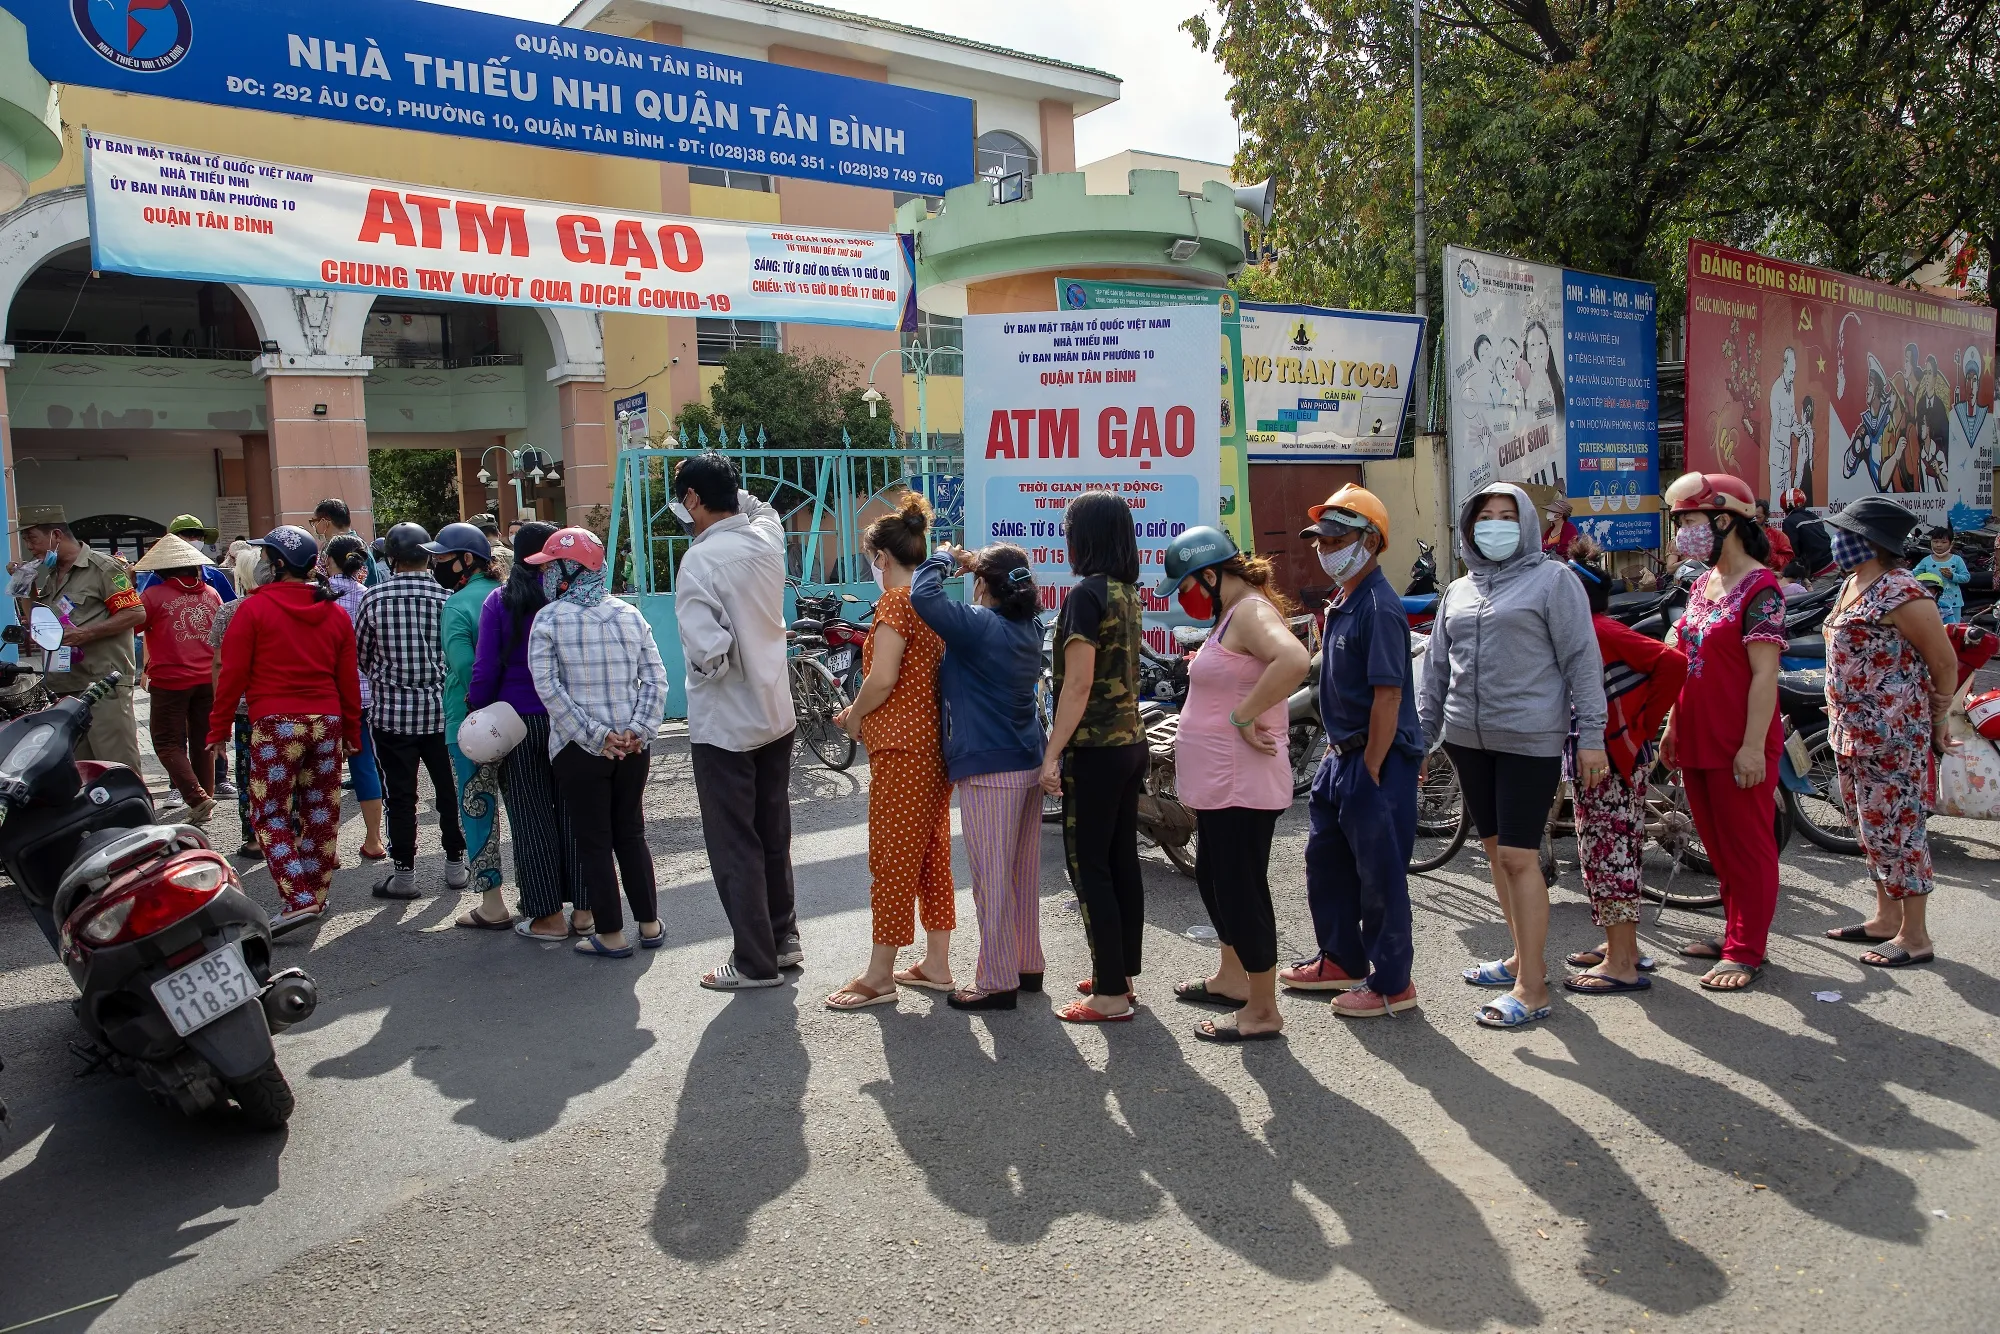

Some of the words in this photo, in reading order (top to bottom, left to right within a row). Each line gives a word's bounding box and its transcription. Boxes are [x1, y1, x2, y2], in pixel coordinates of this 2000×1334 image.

[515, 33, 577, 61] QUẬN
[584, 46, 643, 69] ĐOÀN
[649, 55, 689, 77] TÂN
[697, 62, 742, 85] BÌNH
[287, 33, 392, 81] NHÀ
[404, 52, 537, 102] THIẾU
[552, 76, 622, 114] NHI
[635, 90, 739, 134] QUẬN
[750, 103, 818, 142] TÂN
[829, 115, 905, 155] BÌNH
[227, 75, 265, 96] ĐC:
[273, 82, 312, 103] 292
[318, 85, 348, 108] ÂU
[354, 95, 392, 117] CƠ,
[398, 100, 486, 127] PHƯỜNG
[492, 114, 519, 133] 10,
[524, 118, 576, 140] QUẬN
[582, 124, 617, 144] TÂN
[623, 129, 664, 149] BÌNH
[678, 138, 705, 154] ĐT:
[709, 142, 765, 164] (028)38
[770, 153, 797, 167] 604
[800, 155, 824, 170] 351
[839, 160, 889, 180] (028)39
[893, 169, 917, 183] 749
[920, 172, 943, 186] 760
[106, 140, 133, 155] BAN
[137, 146, 165, 161] MẶT
[168, 151, 201, 166] TRẬN
[204, 155, 221, 169] TỔ
[223, 160, 255, 175] QUỐC
[258, 166, 284, 181] VIỆT
[286, 170, 314, 183] NAM
[159, 166, 187, 181] NHÀ
[190, 170, 225, 185] THIẾU
[229, 174, 250, 188] NHI
[110, 174, 127, 190] ỦY
[131, 180, 158, 195] BAN
[161, 184, 197, 200] NHÂN
[200, 188, 225, 203] DÂN
[229, 193, 278, 209] PHƯỜNG
[282, 200, 296, 211] 10
[143, 206, 191, 228] QUẬN
[196, 211, 229, 230] TÂN
[234, 215, 274, 235] BÌNH
[358, 189, 530, 257] ATM
[556, 215, 704, 281] GẠO
[796, 235, 818, 243] GIAN
[754, 257, 781, 273] SÁNG:
[782, 259, 795, 274] TỪ
[803, 261, 818, 276] GIỜ
[831, 263, 850, 277] ĐẾN
[852, 267, 862, 278] 10
[864, 265, 878, 279] GIỜ
[321, 260, 408, 289] CHUNG
[416, 268, 455, 292] TAY
[462, 272, 524, 301] VƯỢT
[530, 279, 573, 303] QUA
[580, 283, 631, 307] DỊCH
[638, 288, 731, 312] COVID-19
[798, 283, 809, 294] 15
[811, 282, 826, 296] GIỜ
[841, 283, 858, 298] ĐẾN
[860, 287, 870, 299] 17
[872, 286, 885, 301] GIỜ
[1701, 250, 1742, 281] ĐẢNG
[1746, 262, 1785, 289] CỘNG
[1789, 270, 1816, 295] SẢN
[1820, 279, 1846, 303] VIỆT
[1848, 286, 1874, 308] NAM
[1877, 293, 1912, 317] QUANG
[1915, 301, 1939, 322] VINH
[1941, 307, 1969, 327] MUÔN
[1971, 312, 1992, 332] NĂM
[1567, 284, 1582, 302] ANH
[1590, 285, 1606, 305] HÀN
[1613, 291, 1628, 308] HOA
[1634, 292, 1653, 315] NHẬT
[1695, 293, 1711, 313] CHÚC
[1712, 297, 1730, 316] MỪNG
[1731, 299, 1746, 319] NĂM
[1003, 322, 1015, 334] ỦY
[1017, 323, 1036, 334] BAN
[1038, 322, 1057, 335] MẶT
[1060, 322, 1084, 334] TRẬN
[1086, 318, 1098, 332] TỔ
[1100, 318, 1124, 332] QUỐC
[1127, 319, 1147, 332] VIỆT
[1149, 318, 1171, 329] NAM
[1053, 335, 1072, 347] NHÀ
[1075, 333, 1100, 347] THIẾU
[1102, 335, 1119, 346] NHI
[1018, 351, 1031, 363] ỦY
[1032, 352, 1051, 363] BAN
[1053, 351, 1079, 362] NHÂN
[1081, 350, 1100, 361] DÂN
[1102, 349, 1140, 361] PHƯỜNG
[1143, 350, 1155, 360] 10
[1040, 369, 1074, 387] QUẬN
[1077, 369, 1102, 384] TÂN
[1105, 368, 1136, 383] BÌNH
[1276, 356, 1336, 386] TRAN
[1339, 360, 1399, 390] YOGA
[1313, 400, 1337, 411] PHÒNG
[1324, 391, 1339, 400] CĂN
[1340, 390, 1356, 401] BẢN
[984, 408, 1080, 460] ATM
[1098, 405, 1195, 470] GẠO
[1261, 434, 1276, 442] CAO
[1527, 424, 1550, 453] SINH
[1580, 458, 1598, 468] TOPIK
[1602, 459, 1614, 469] HSK
[1018, 481, 1048, 492] THỜI
[1050, 483, 1082, 492] GIAN
[1122, 480, 1163, 494] ĐỘNG:
[1034, 497, 1047, 509] TỪ
[1048, 497, 1067, 509] THỨ
[1127, 496, 1146, 509] SÁU
[1921, 498, 1935, 511] HỌC
[1935, 497, 1946, 511] TẬP
[991, 519, 1027, 538] SÁNG:
[1030, 520, 1046, 538] TỪ
[1047, 522, 1055, 537] 8
[1146, 518, 1167, 538] GIỜ
[1032, 546, 1048, 564] TỪ
[1050, 549, 1064, 564] 15
[1138, 549, 1152, 565] 17
[1191, 544, 1216, 555] PIAGGIO
[114, 595, 130, 609] BẢO
[167, 954, 231, 1001] 63-B5
[175, 972, 251, 1028] 118.57
